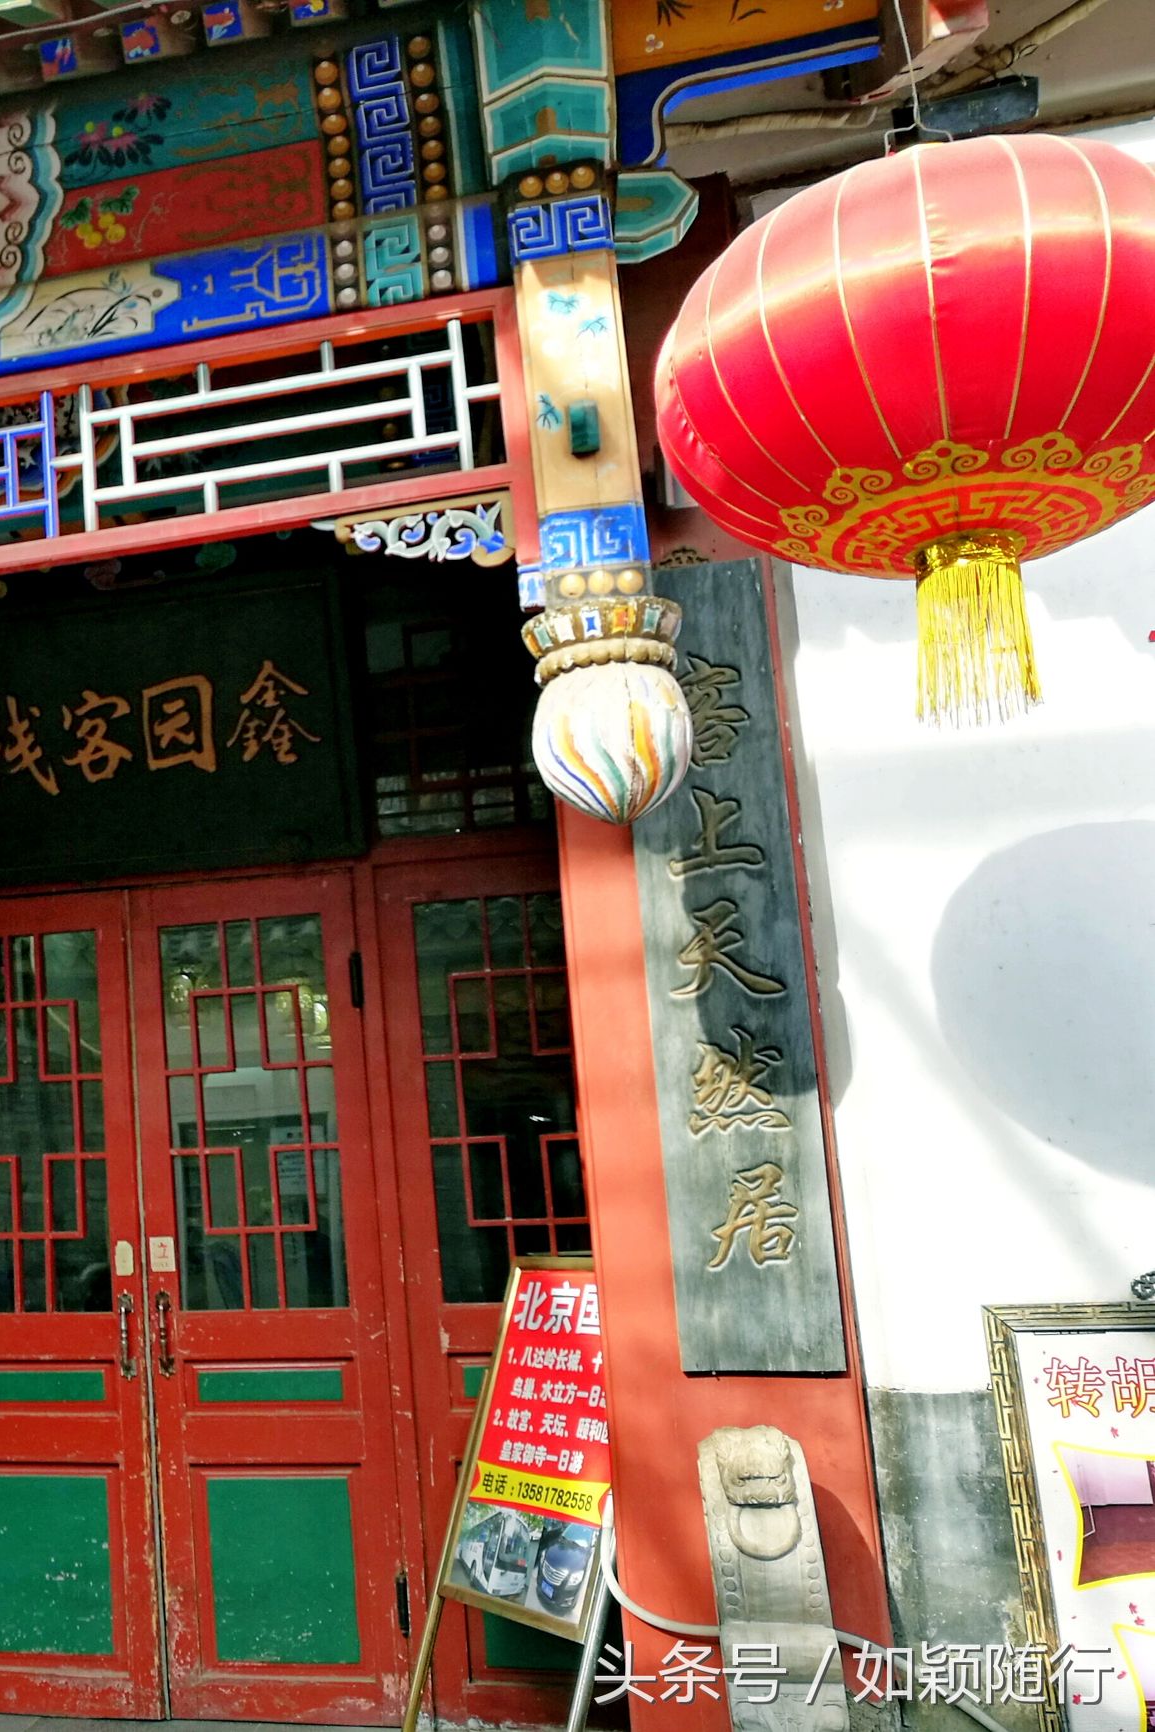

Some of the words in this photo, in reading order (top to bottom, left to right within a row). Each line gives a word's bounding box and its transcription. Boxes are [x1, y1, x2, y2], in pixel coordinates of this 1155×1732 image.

[667, 655, 792, 1271] 客上天然居
